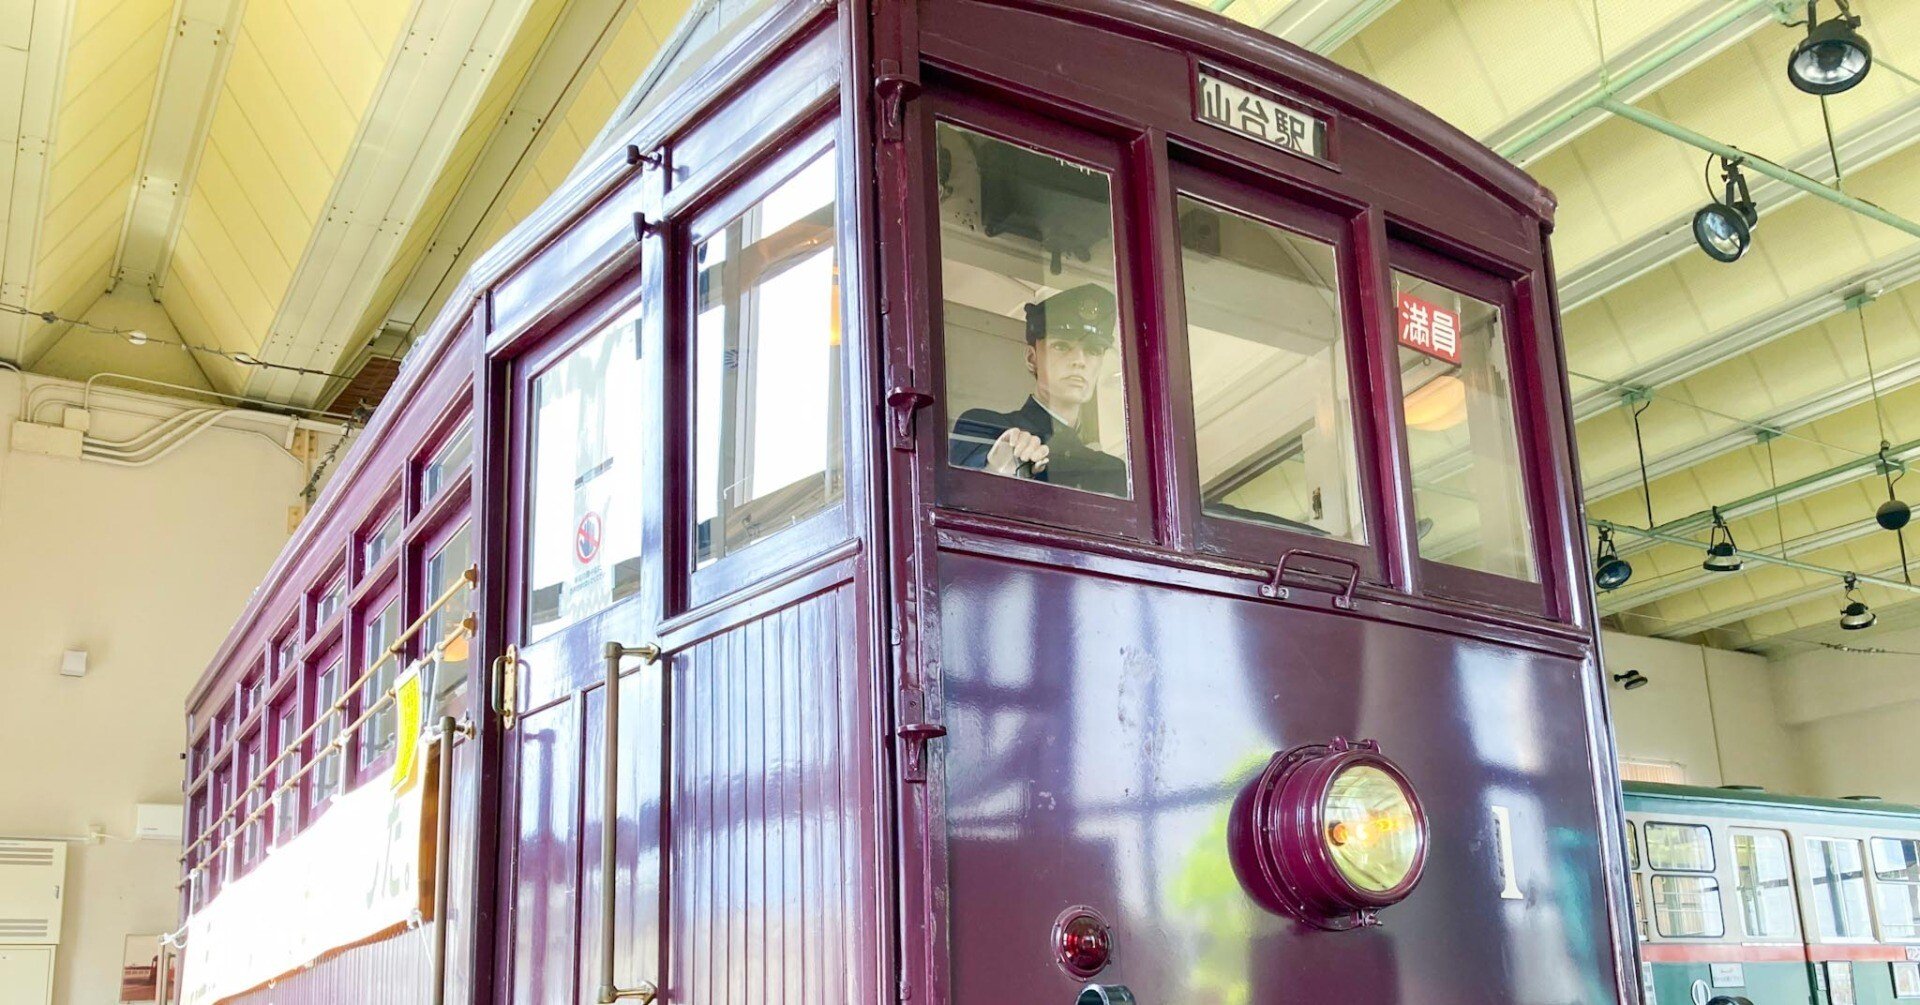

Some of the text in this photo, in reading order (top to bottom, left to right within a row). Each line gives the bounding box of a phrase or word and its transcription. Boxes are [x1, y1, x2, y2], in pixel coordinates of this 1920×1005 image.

[1199, 77, 1306, 153] 仙台駅
[1402, 300, 1456, 358] 満員
[1491, 805, 1524, 900] 1
